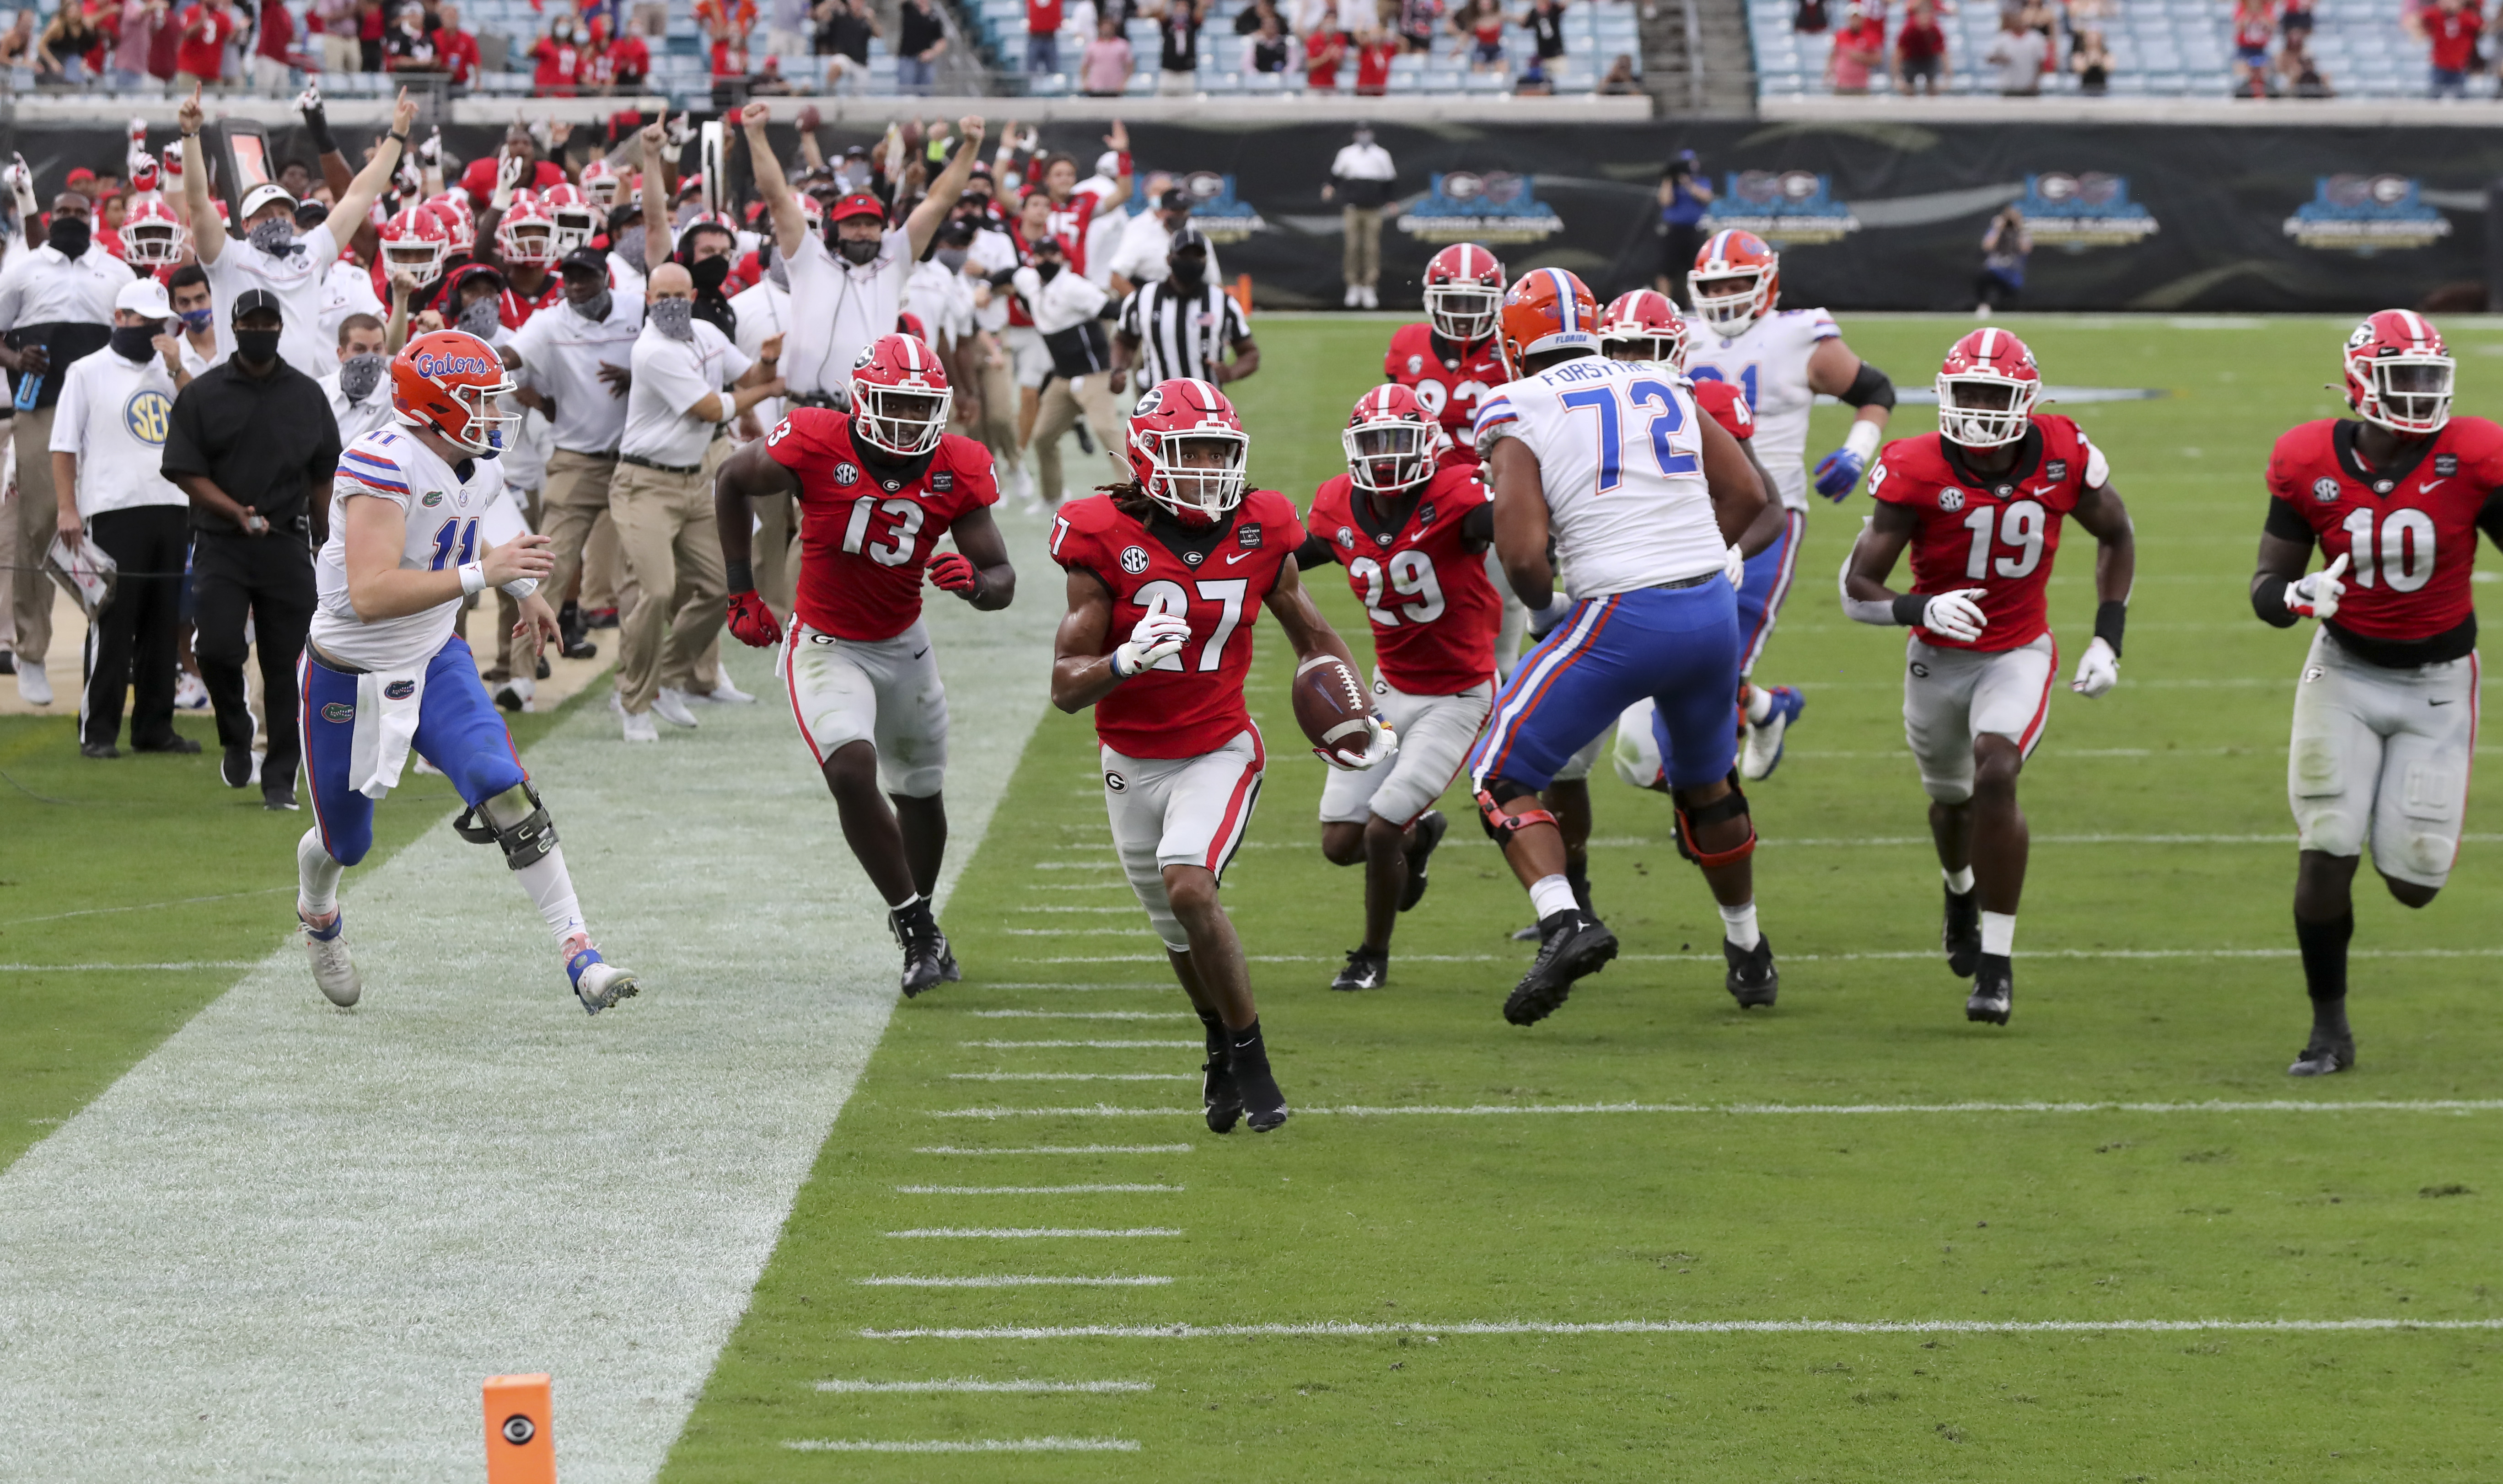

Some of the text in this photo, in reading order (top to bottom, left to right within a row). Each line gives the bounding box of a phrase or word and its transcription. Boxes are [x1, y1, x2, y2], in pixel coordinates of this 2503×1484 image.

[1556, 335, 1587, 344] FLORIDA
[416, 352, 487, 379] Gators
[1557, 377, 1700, 496] 72
[836, 463, 856, 484] SEC
[884, 480, 900, 490] G
[1939, 488, 1964, 511] SEC
[1996, 485, 2013, 497] G
[2314, 477, 2340, 502] SEC
[842, 495, 924, 567] 13
[1376, 533, 1393, 545] G
[1964, 500, 2046, 580] 19
[429, 516, 479, 572] 11
[2342, 507, 2436, 593] 10
[1123, 548, 1147, 573] SEC
[1186, 552, 1203, 563] G
[1348, 549, 1447, 627] 29
[1133, 579, 1249, 672] 27
[811, 634, 835, 644] G
[1910, 662, 1929, 679] G
[1375, 681, 1388, 694] G
[1106, 771, 1128, 790] G
